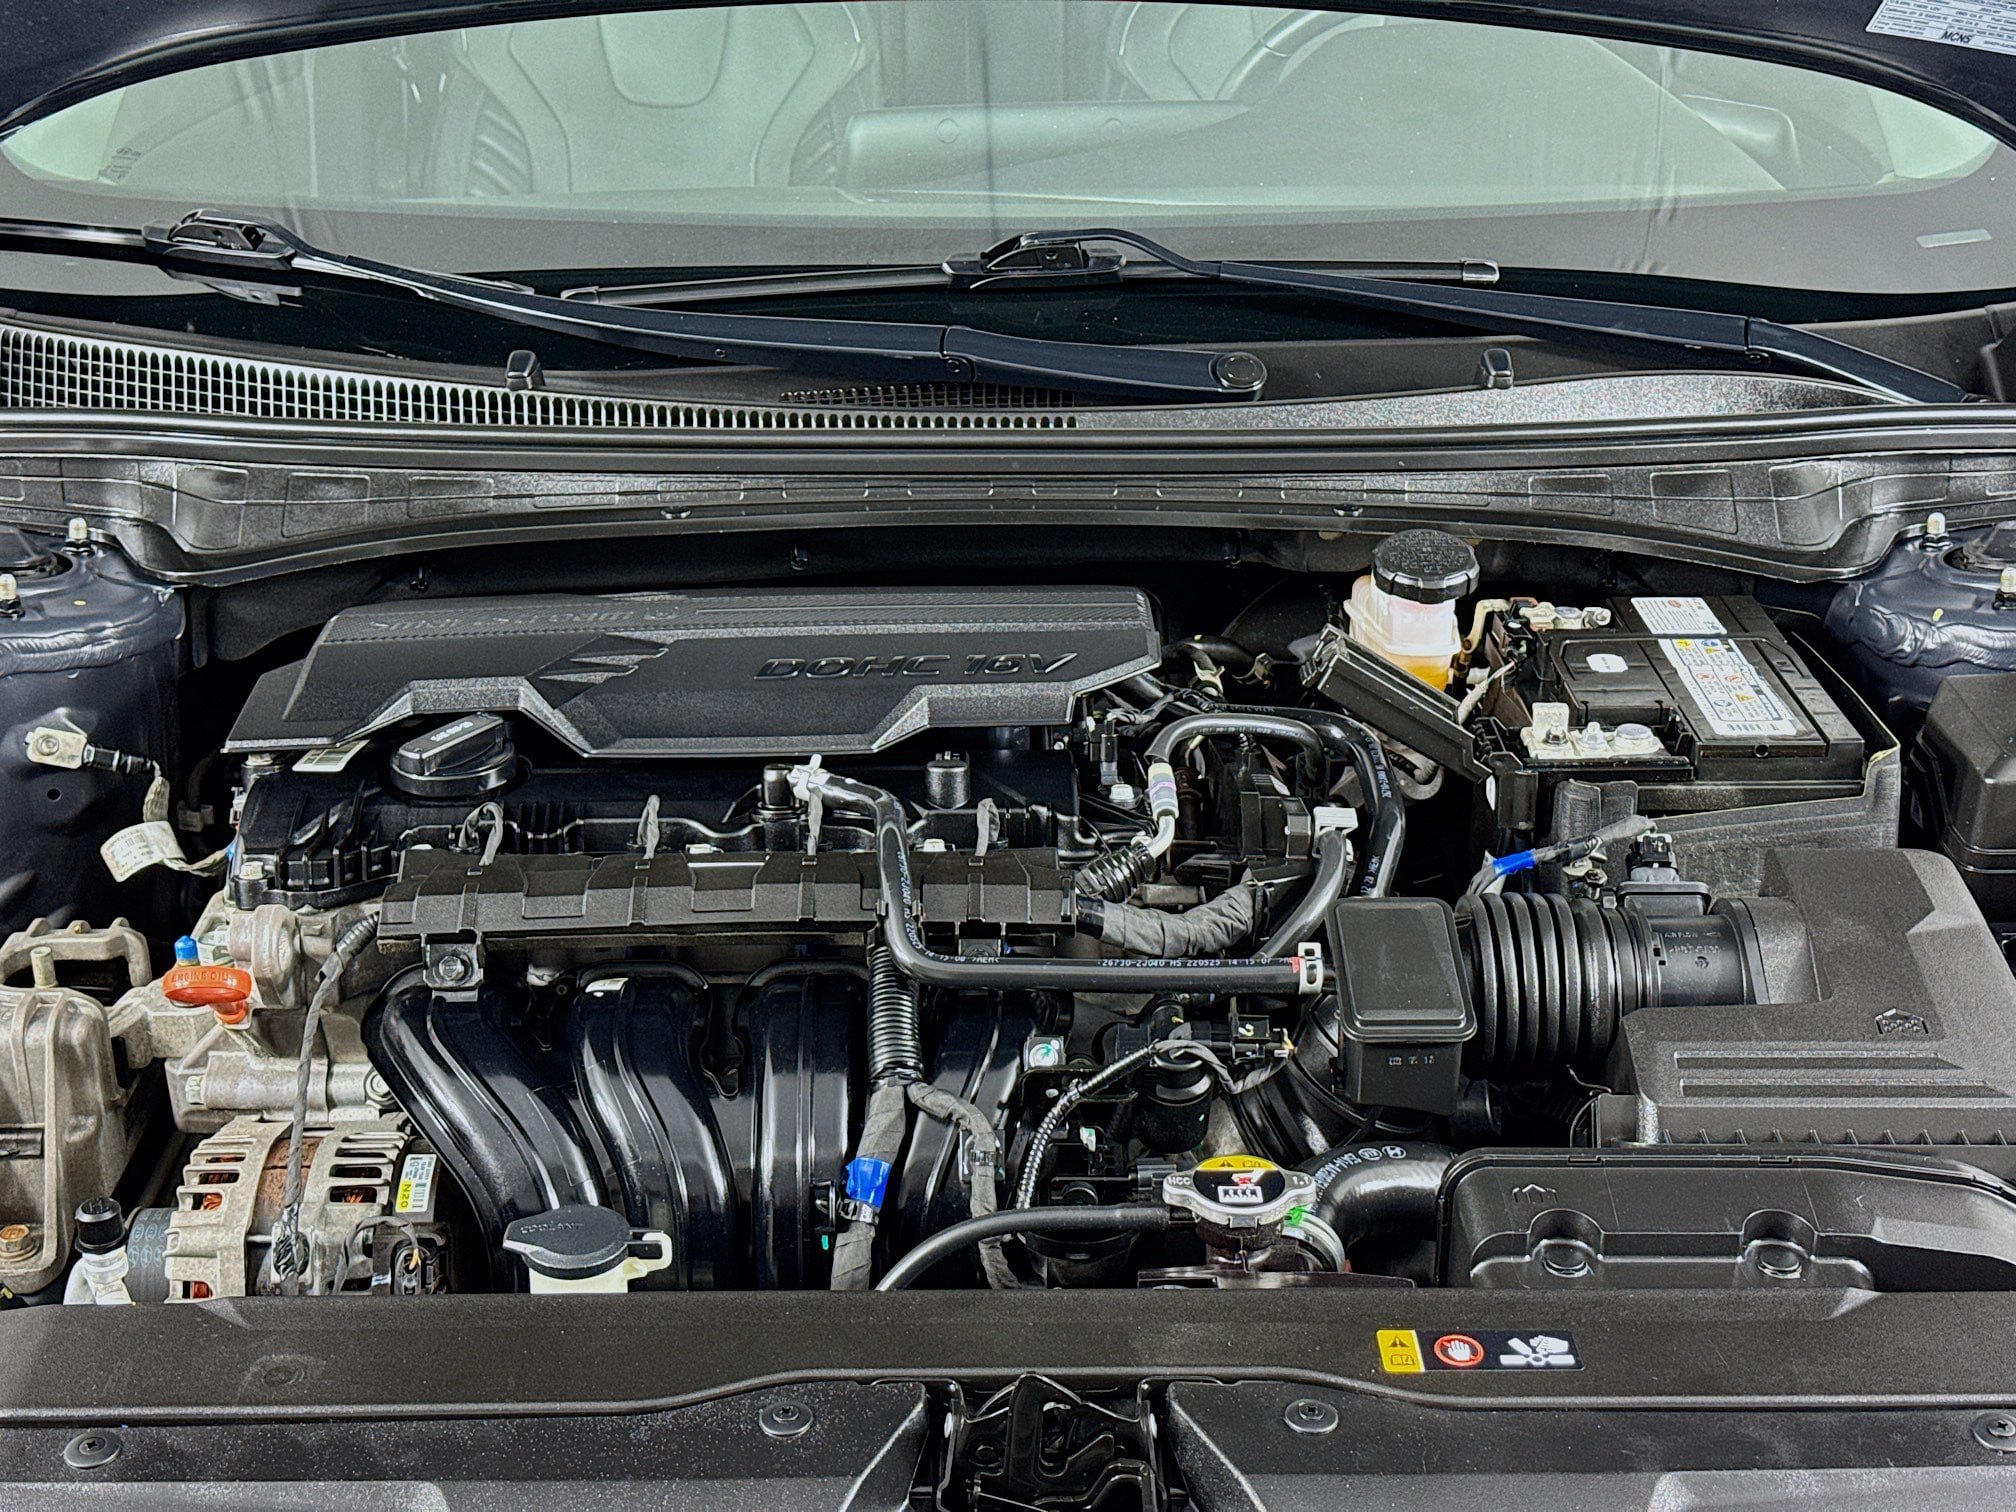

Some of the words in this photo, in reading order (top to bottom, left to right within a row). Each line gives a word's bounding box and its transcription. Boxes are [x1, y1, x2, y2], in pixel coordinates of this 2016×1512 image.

[753, 655, 951, 680] DOHC
[963, 652, 1079, 676] 16V
[1186, 958, 1221, 967] 220525
[172, 971, 208, 983] ENGINE
[209, 971, 230, 982] OIL
[1167, 1175, 1191, 1186] HCC
[1292, 1175, 1309, 1185] 1.1
[520, 1222, 585, 1235] COOLANT
